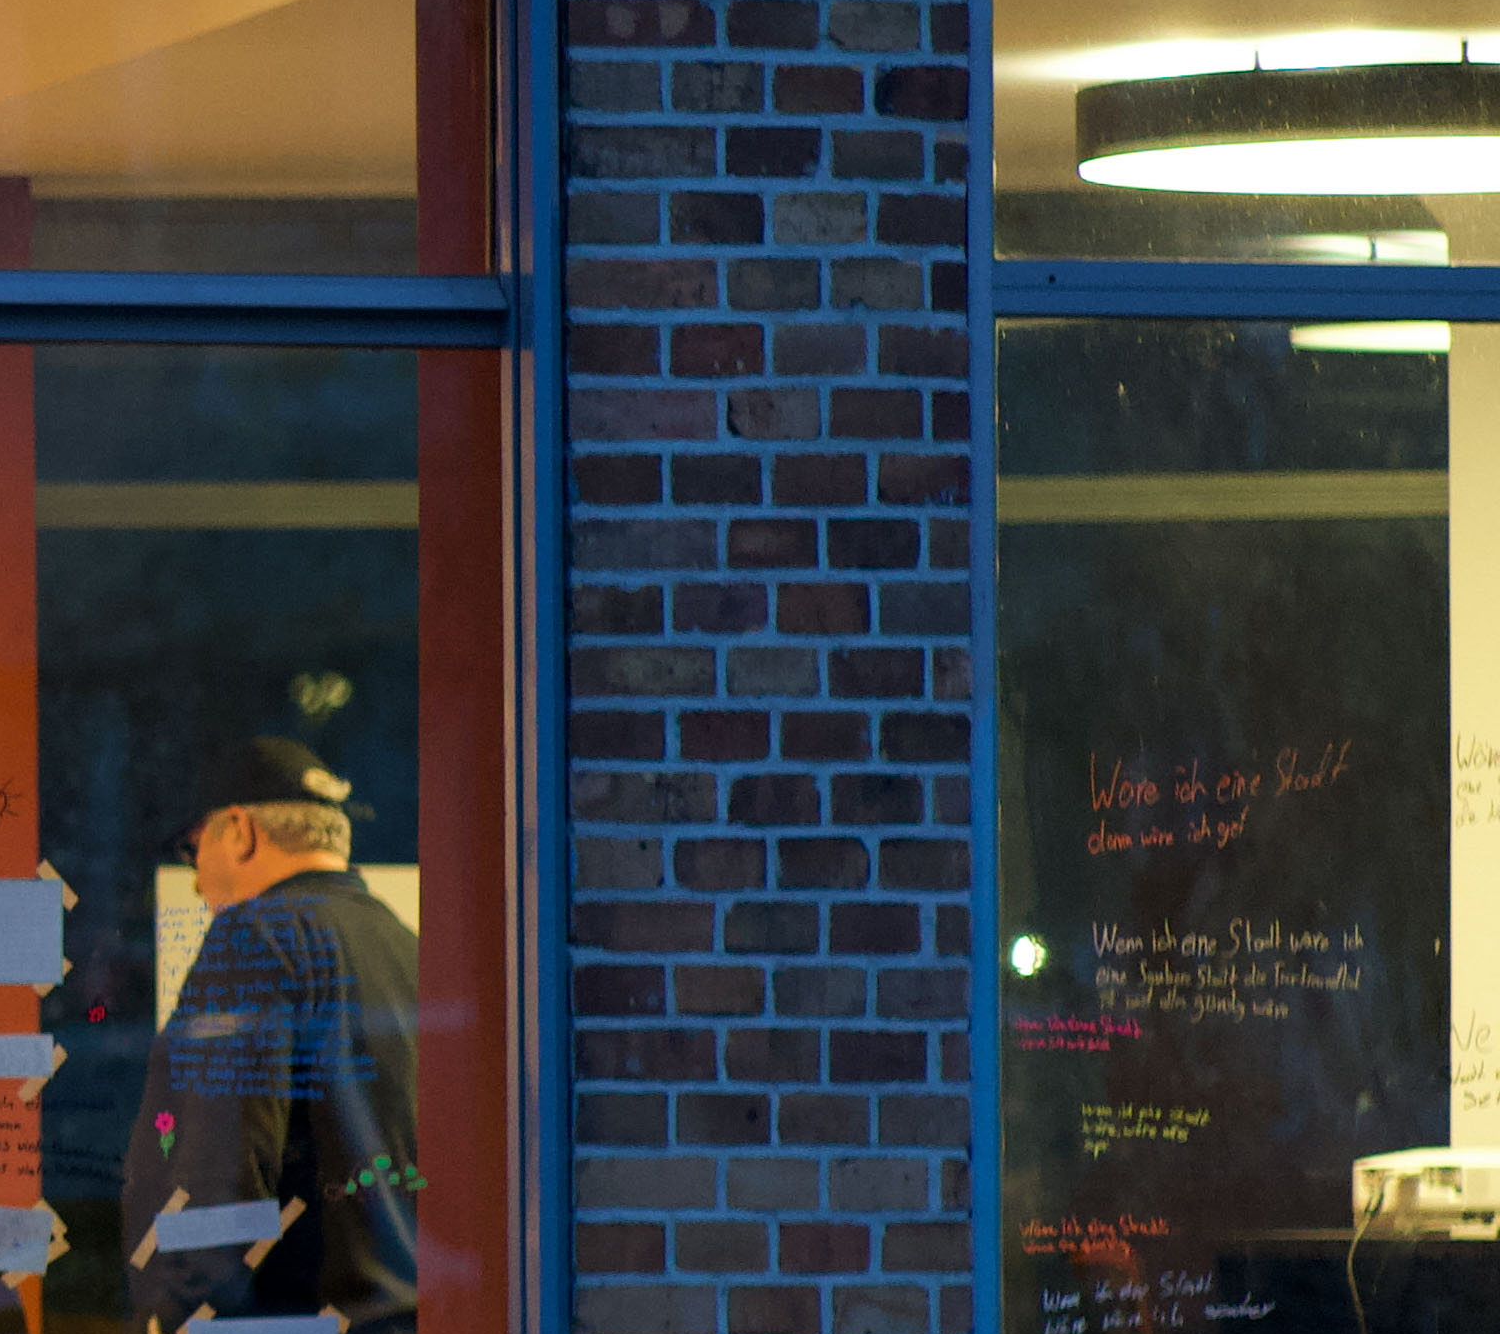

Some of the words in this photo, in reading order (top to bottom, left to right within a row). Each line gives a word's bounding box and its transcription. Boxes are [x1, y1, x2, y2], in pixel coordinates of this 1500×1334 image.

[1175, 757, 1207, 805] ich
[1216, 770, 1262, 804] eine
[1275, 739, 1352, 798] Stadt
[1187, 812, 1211, 844] ich
[1152, 917, 1177, 952] ich
[1180, 929, 1217, 958] eine
[1222, 917, 1282, 959] Stadt
[1343, 923, 1364, 952] ich
